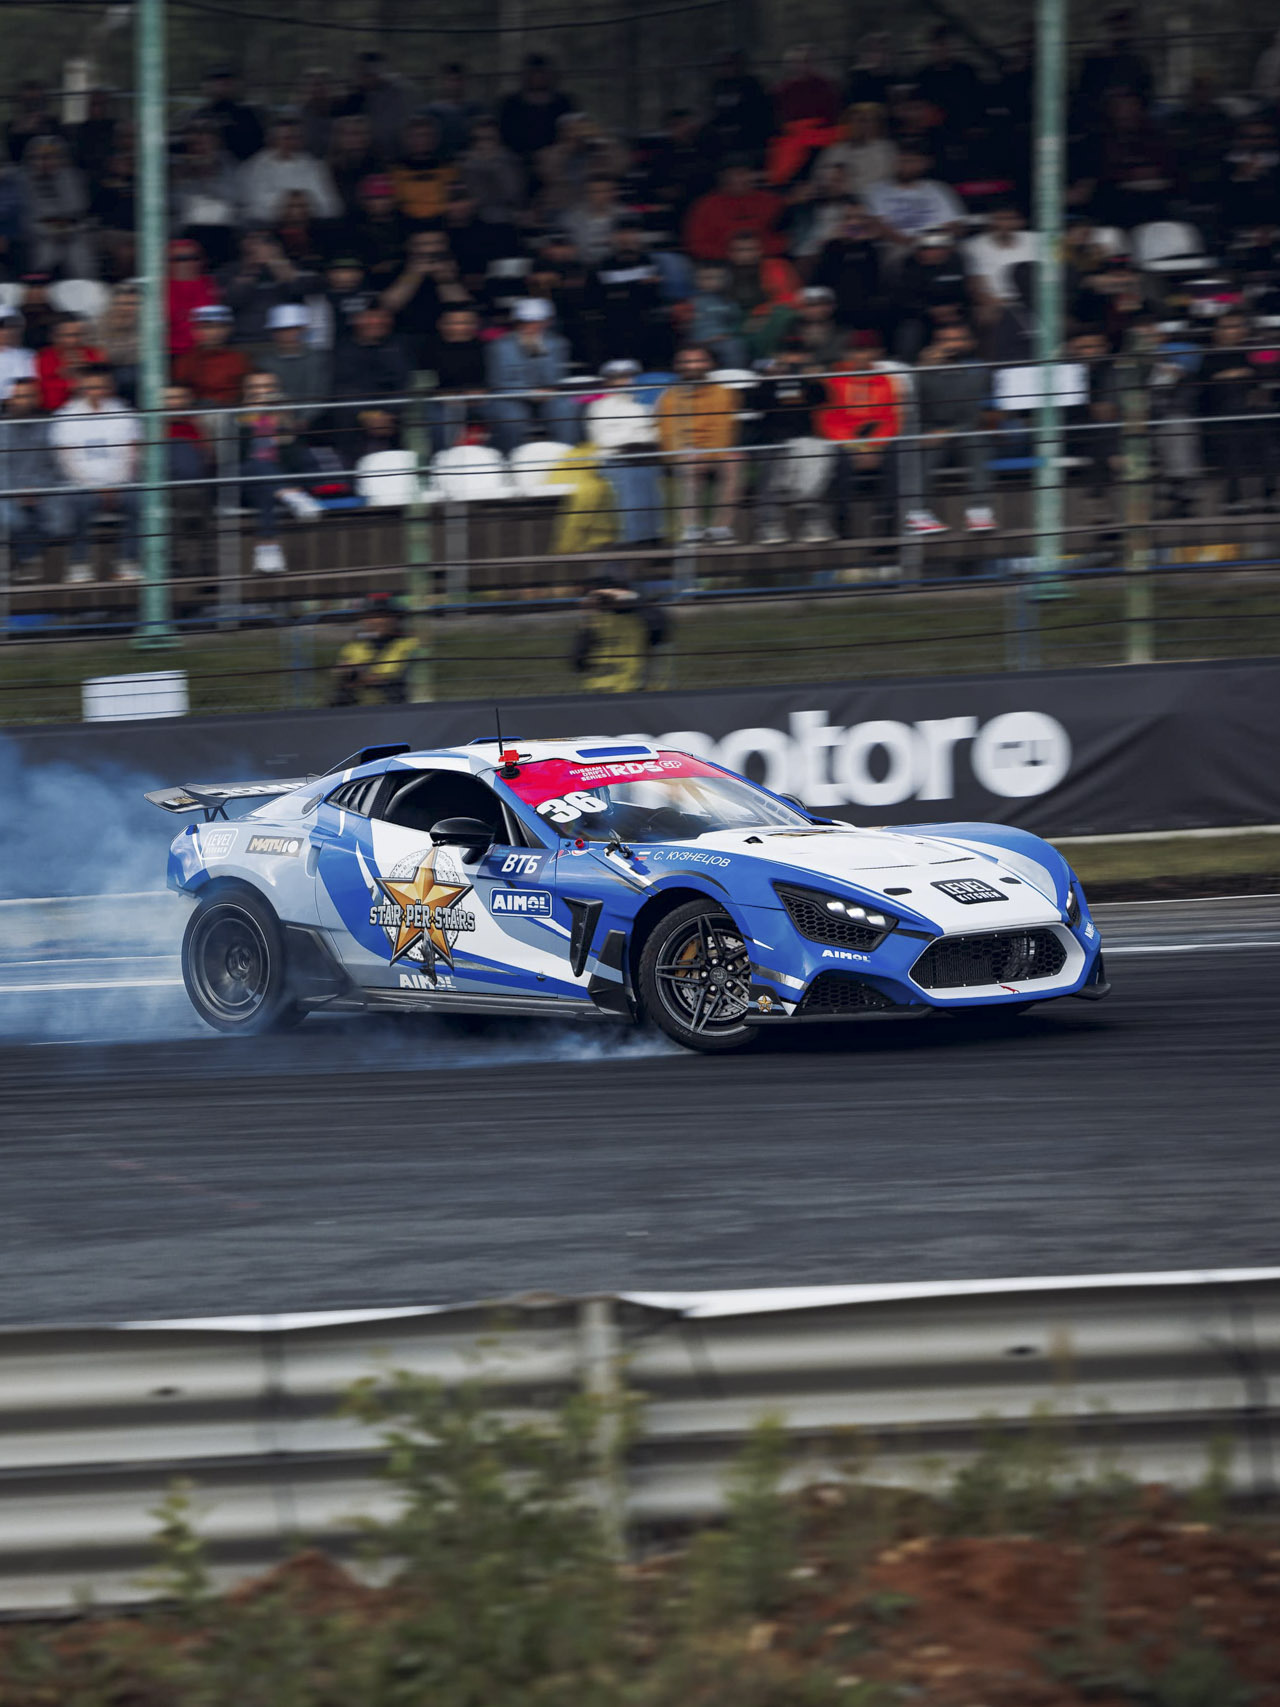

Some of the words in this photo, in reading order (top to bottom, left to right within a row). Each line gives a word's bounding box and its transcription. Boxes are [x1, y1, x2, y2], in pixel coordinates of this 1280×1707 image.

[582, 769, 604, 777] DRIFT
[606, 761, 664, 776] RDS
[580, 773, 608, 781] SERIES
[536, 791, 608, 823] 36
[207, 833, 233, 846] LEVEL
[502, 854, 542, 874] ВТБ
[667, 851, 731, 868] КУЗНЕЦОВ
[939, 879, 992, 895] LEVEL
[493, 894, 549, 912] AIMOL
[957, 890, 1002, 902] KITCHEN
[370, 904, 403, 926] STAR
[435, 906, 476, 931] STARS
[821, 949, 871, 963] AIMOL
